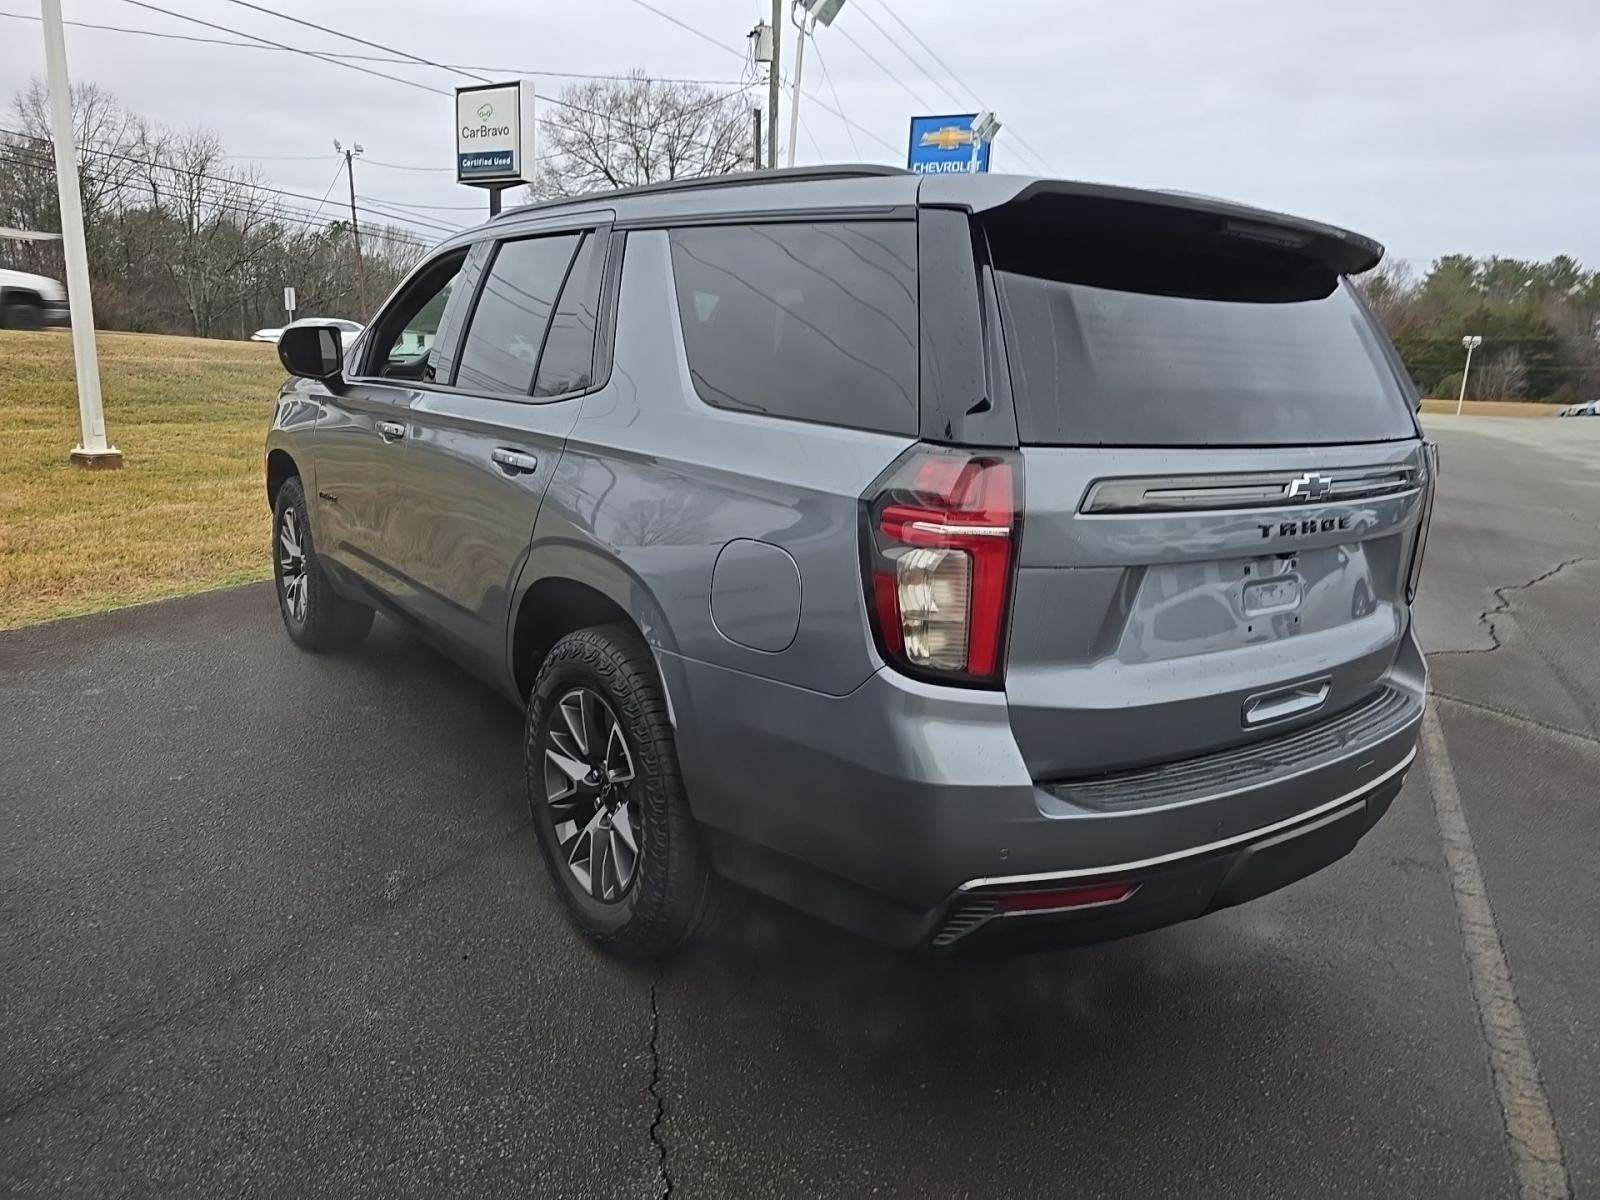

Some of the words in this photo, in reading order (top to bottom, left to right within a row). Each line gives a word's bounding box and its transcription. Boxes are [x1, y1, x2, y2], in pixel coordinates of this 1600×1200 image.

[462, 125, 510, 139] CarBravo
[462, 157, 493, 167] Certified
[494, 156, 511, 166] Used
[1258, 517, 1350, 538] TAHOE
